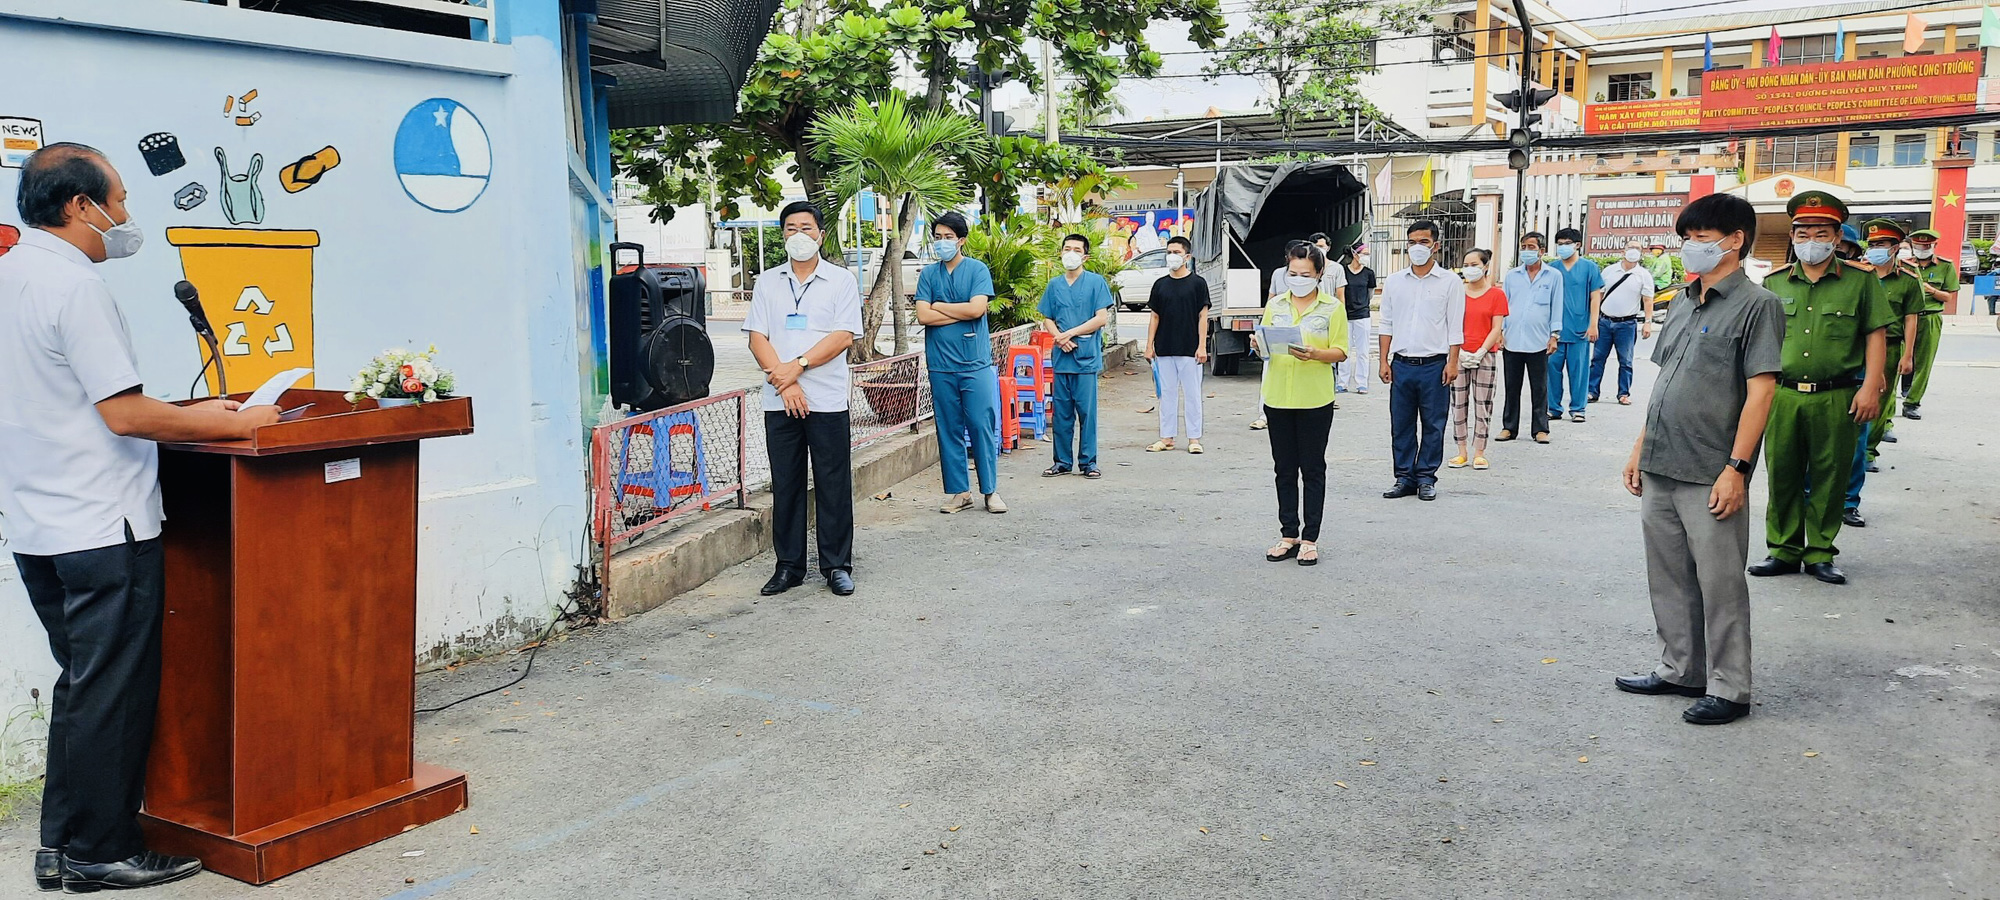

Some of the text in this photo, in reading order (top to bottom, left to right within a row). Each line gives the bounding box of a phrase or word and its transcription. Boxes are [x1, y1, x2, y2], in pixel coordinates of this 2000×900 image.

[1711, 76, 1729, 91] ĐẢNG
[1746, 73, 1758, 91] HỘI
[1780, 71, 1799, 86] NHÂN
[1800, 69, 1814, 84] DÂN
[1831, 69, 1846, 82] BAN
[1847, 66, 1867, 81] NHÂN
[1869, 65, 1883, 80] DÂN
[1886, 62, 1917, 79] PHƯỜNG
[1919, 63, 1940, 76] LONG
[1868, 85, 1887, 93] DUY
[1889, 83, 1918, 91] TRINH
[1702, 109, 1721, 118] PARTY
[1723, 106, 1759, 117] COMMITTEE
[1764, 104, 1794, 114] PEOPLE'S
[1826, 99, 1857, 110] PEOPLE'S
[1858, 97, 1898, 108] COMMITTEE
[1899, 97, 1909, 105] OF
[1909, 95, 1927, 105] LONG
[2, 125, 38, 137] NEWS
[1600, 210, 1674, 229] ỦY BAN NHÂN DÂN
[1591, 231, 1626, 250] PHƯỜNG
[1626, 235, 1649, 249] NG
